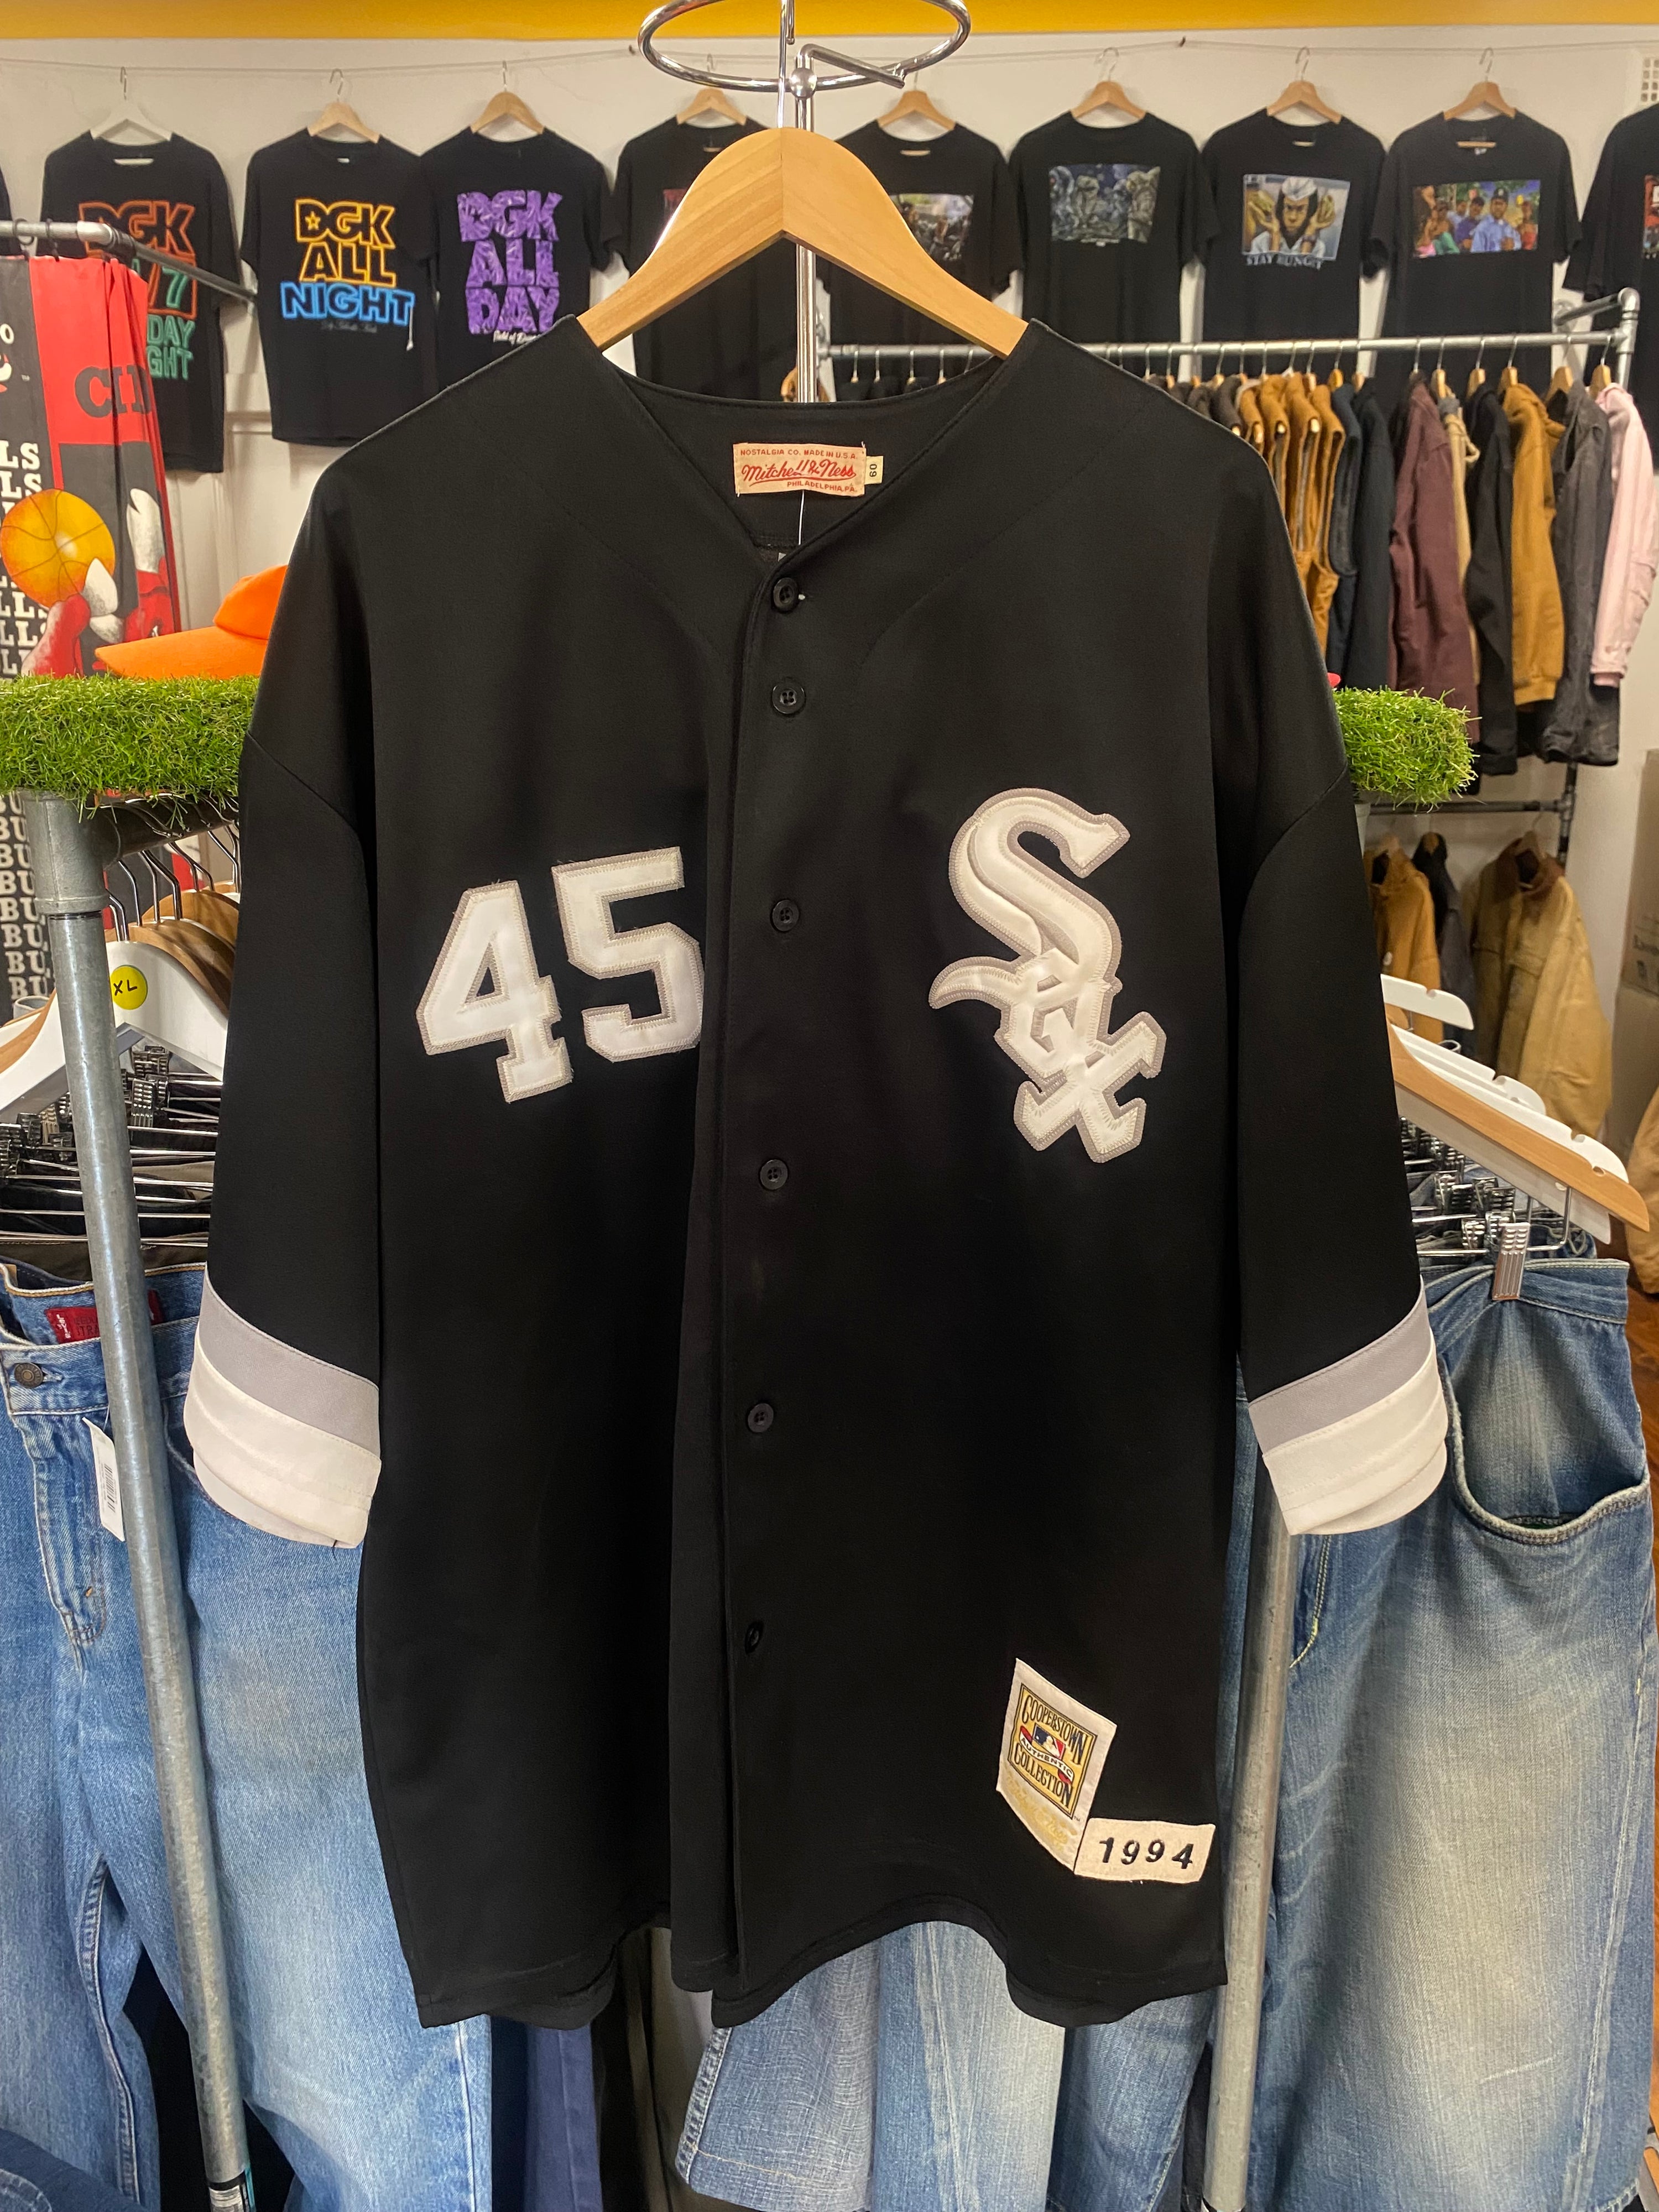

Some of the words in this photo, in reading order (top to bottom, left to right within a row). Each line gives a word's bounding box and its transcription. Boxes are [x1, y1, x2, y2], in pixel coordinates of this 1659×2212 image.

[295, 198, 396, 250] DGK
[457, 190, 563, 242] DGK
[299, 241, 397, 288] ALL
[466, 239, 560, 288] ALL
[280, 281, 415, 327] NIGHT
[465, 286, 560, 335] DAY
[147, 314, 196, 349] DAY
[146, 345, 194, 380] GHT
[742, 460, 810, 481] Mitchell
[808, 460, 820, 475] &
[819, 459, 857, 477] Ness
[113, 979, 138, 996] XL
[416, 846, 705, 1104] 45
[1022, 1694, 1088, 1766] COOPERSTOWN
[1014, 1743, 1073, 1809] COLLECTION
[1021, 1737, 1073, 1778] AUTHENTIC
[1099, 1837, 1194, 1870] 1994
